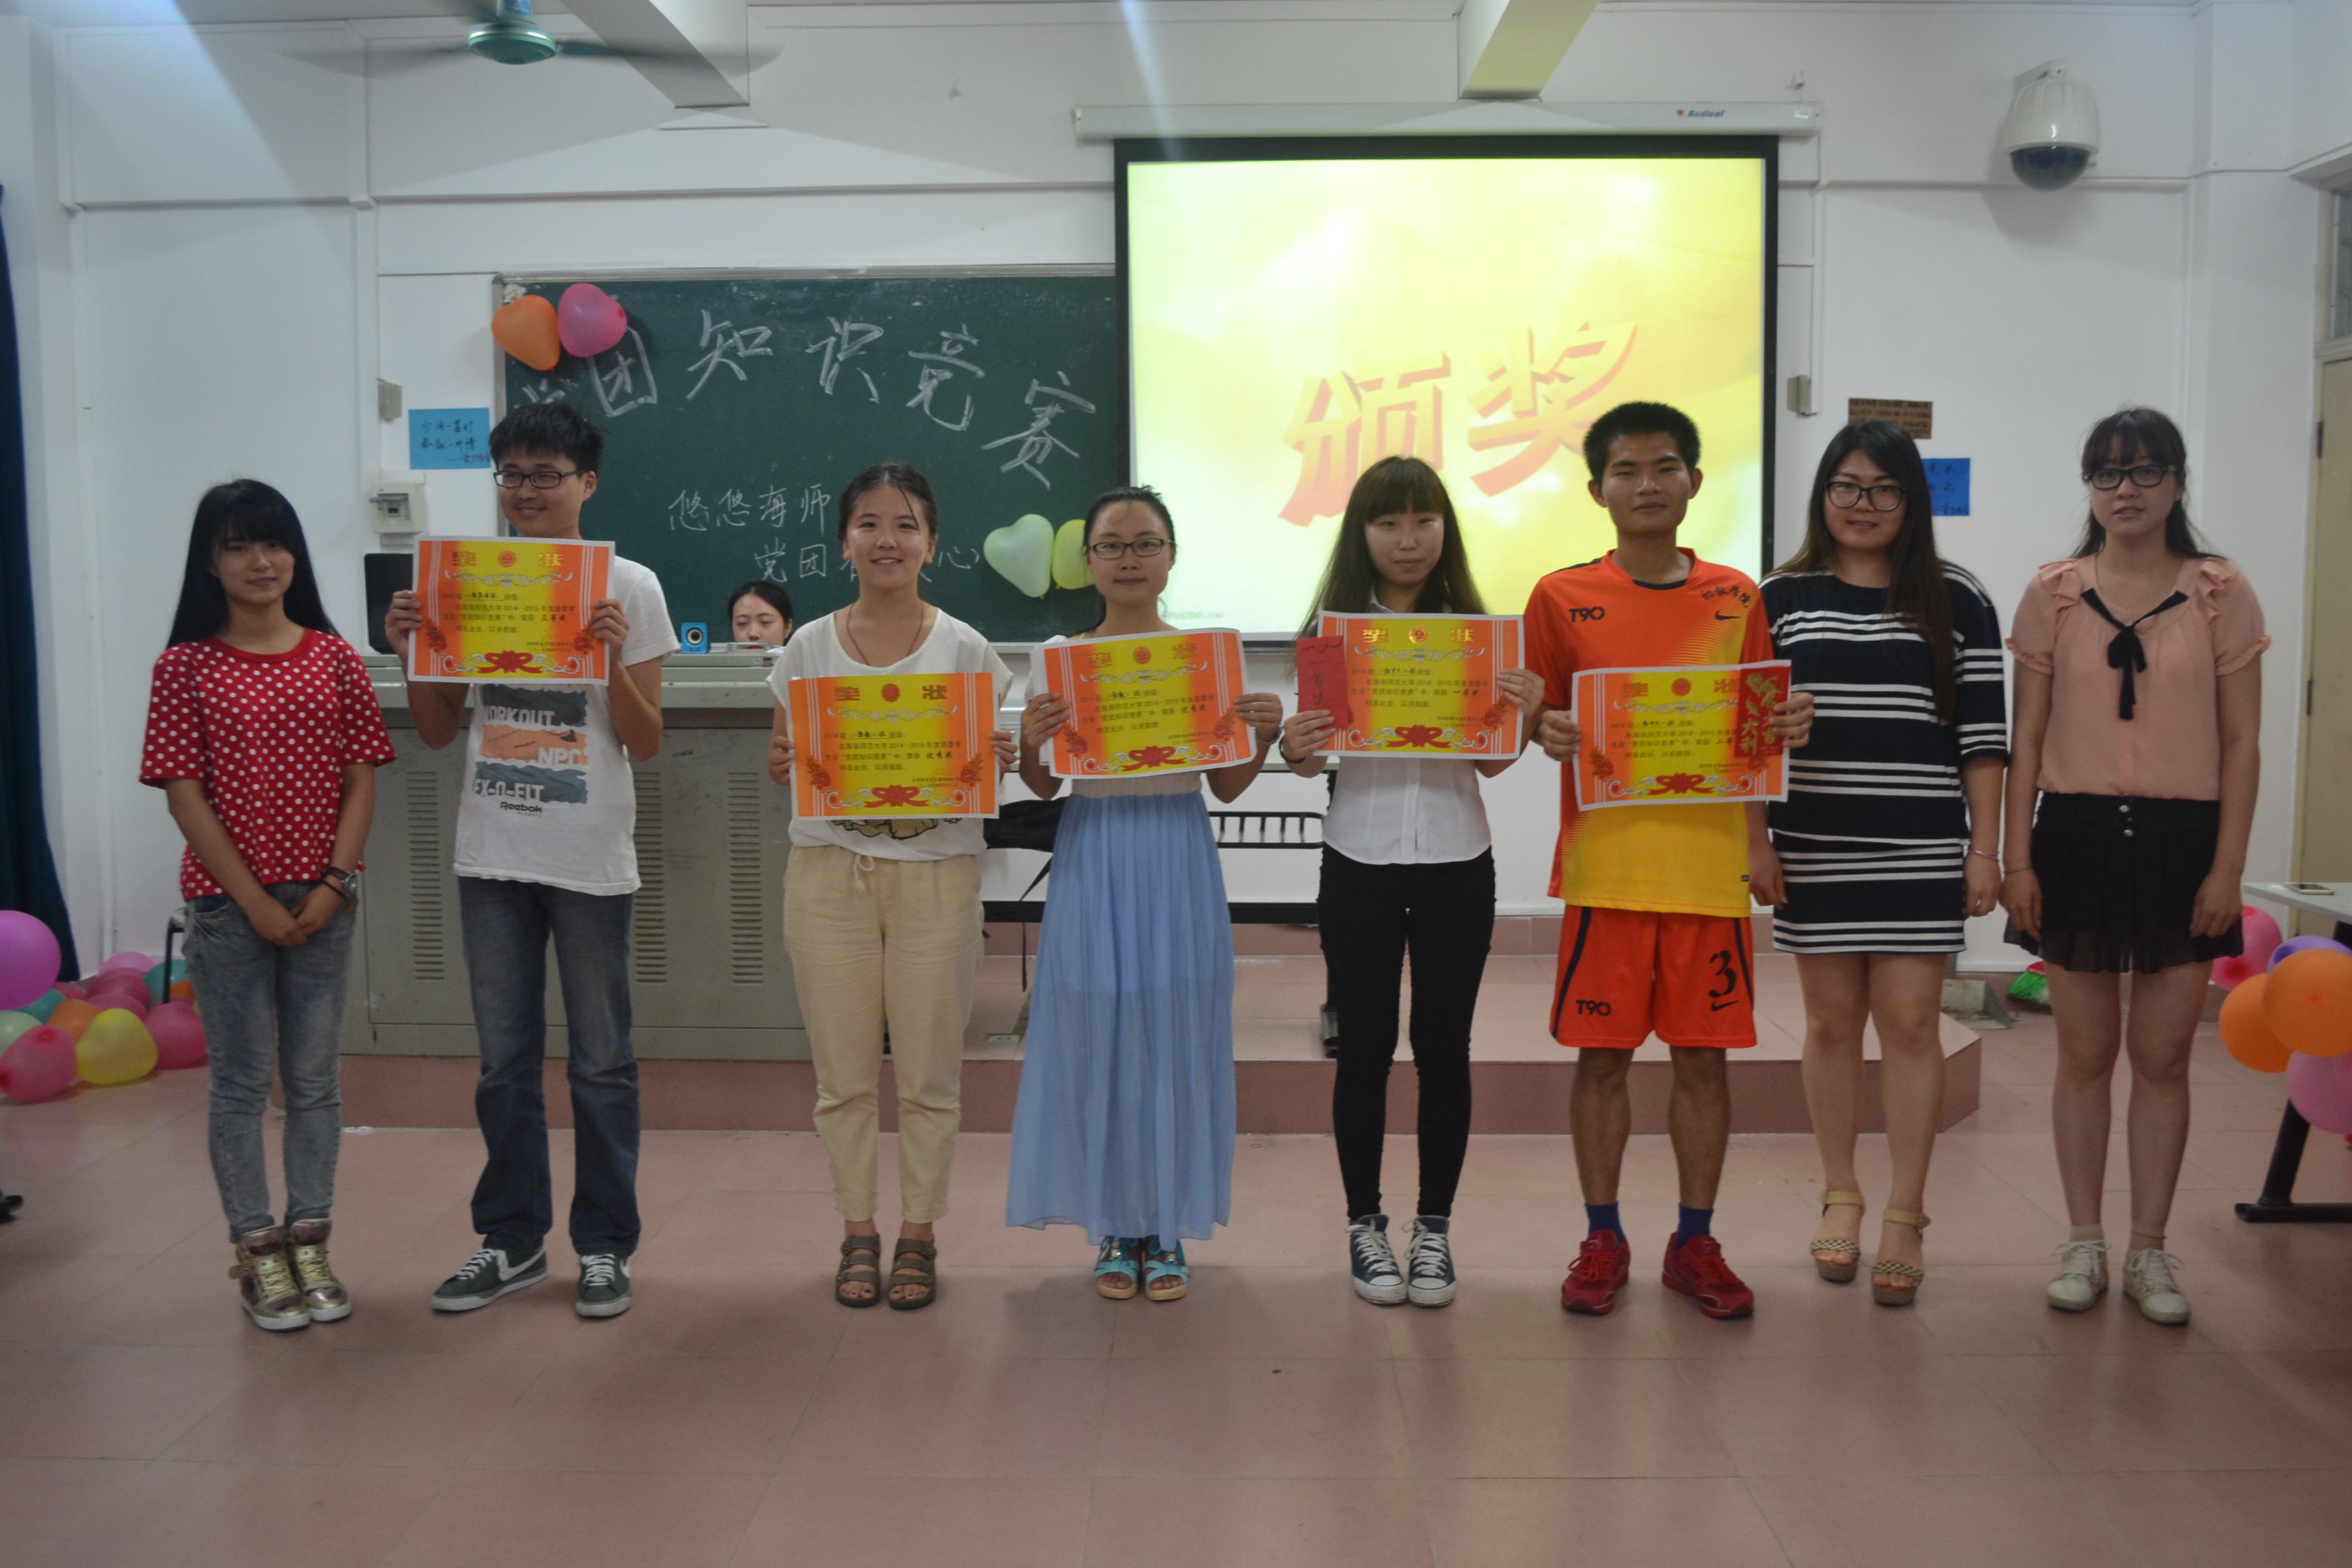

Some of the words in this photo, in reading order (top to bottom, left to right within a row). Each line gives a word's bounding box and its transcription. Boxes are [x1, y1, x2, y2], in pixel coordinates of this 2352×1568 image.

[1687, 110, 1725, 118] Redleaf
[1279, 321, 1637, 527] 颁奖
[668, 484, 831, 536] 悠悠海师
[500, 802, 542, 813] Reebok
[1708, 950, 1737, 998] 3
